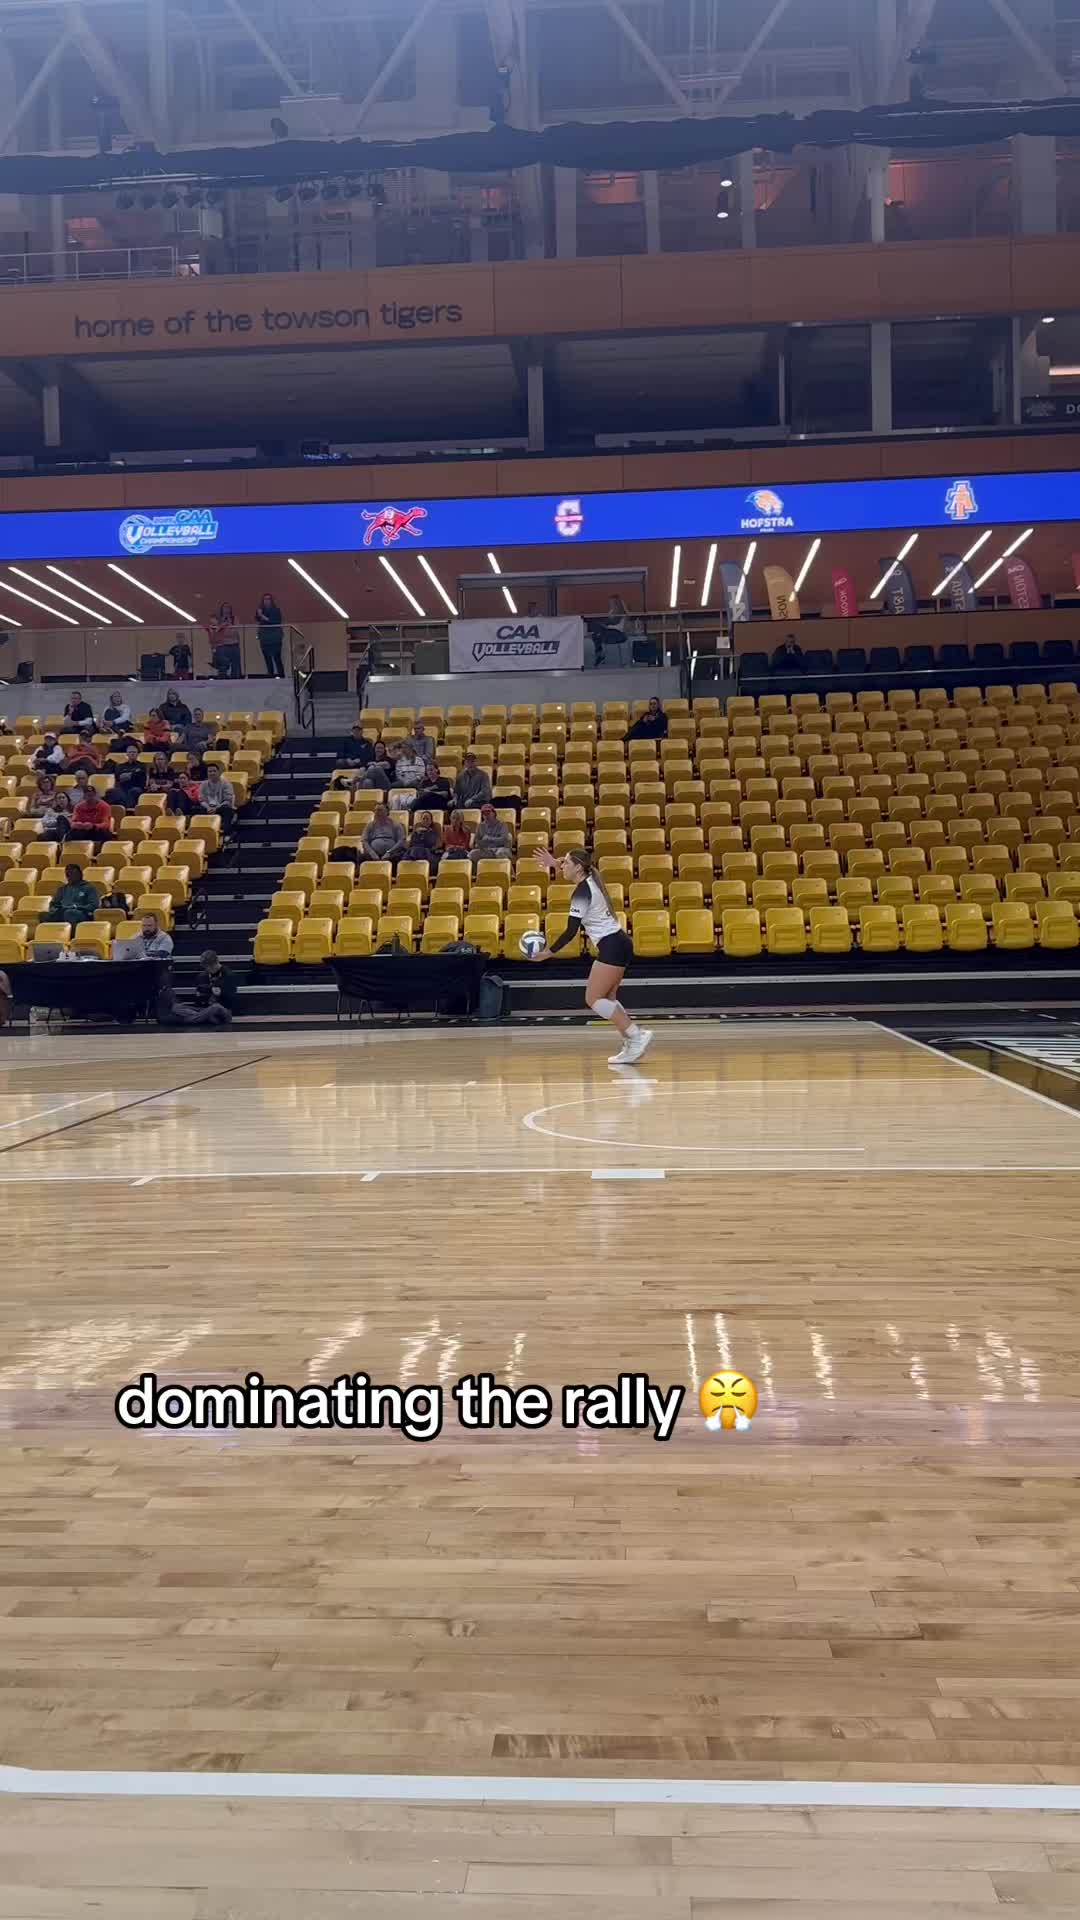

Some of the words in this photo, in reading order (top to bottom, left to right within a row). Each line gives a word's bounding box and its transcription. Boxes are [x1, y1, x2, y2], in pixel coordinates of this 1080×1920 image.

[74, 314, 154, 338] home
[164, 310, 195, 335] of
[204, 309, 252, 333] the
[261, 307, 370, 330] towson
[379, 302, 463, 329] tigers
[176, 509, 213, 523] CAA
[741, 516, 794, 529] HOFSTRA
[126, 524, 217, 545] VOLLEYBALL
[496, 624, 540, 640] CAA
[473, 641, 560, 662] VOLLEYBALL
